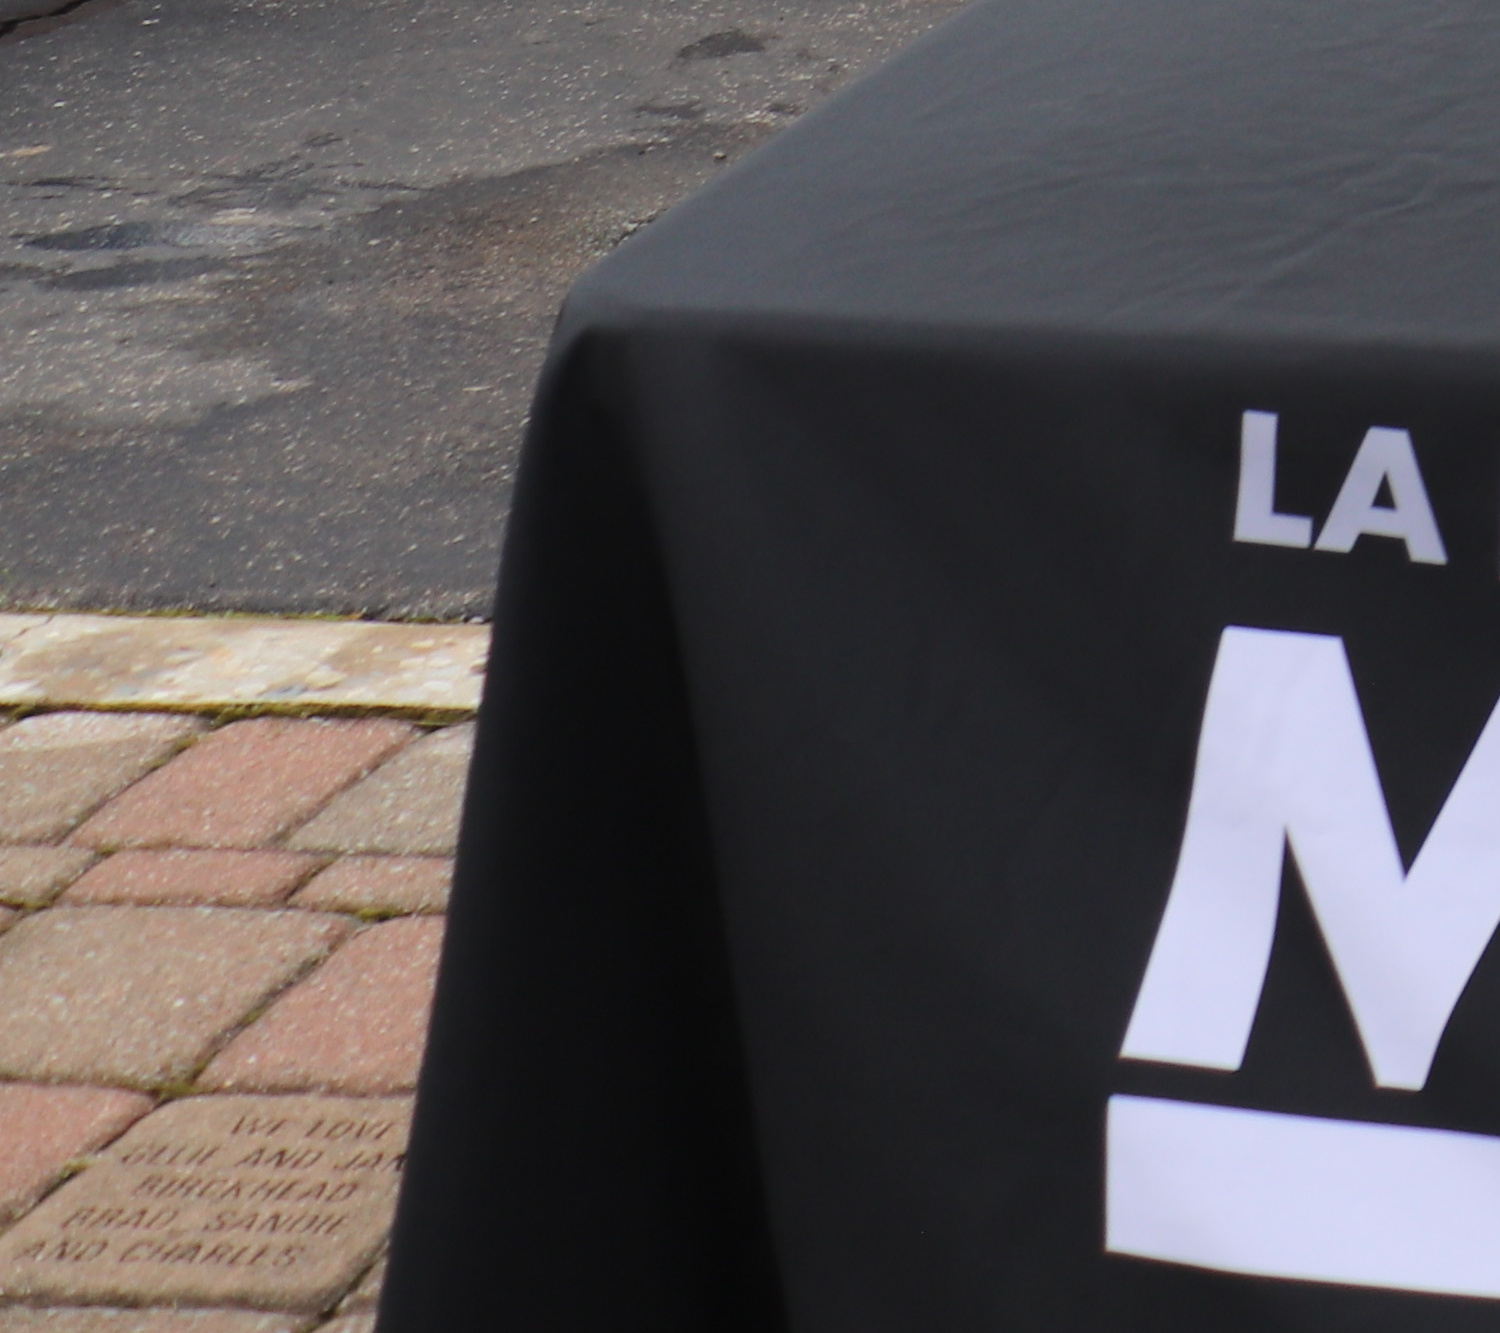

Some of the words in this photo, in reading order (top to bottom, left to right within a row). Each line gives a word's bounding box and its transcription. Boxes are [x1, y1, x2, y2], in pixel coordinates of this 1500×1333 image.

[1231, 408, 1448, 564] LA
[304, 1119, 400, 1141] LOVE
[234, 1147, 324, 1170] AND
[13, 1238, 109, 1264] AND
[118, 1239, 307, 1268] CHARLES
